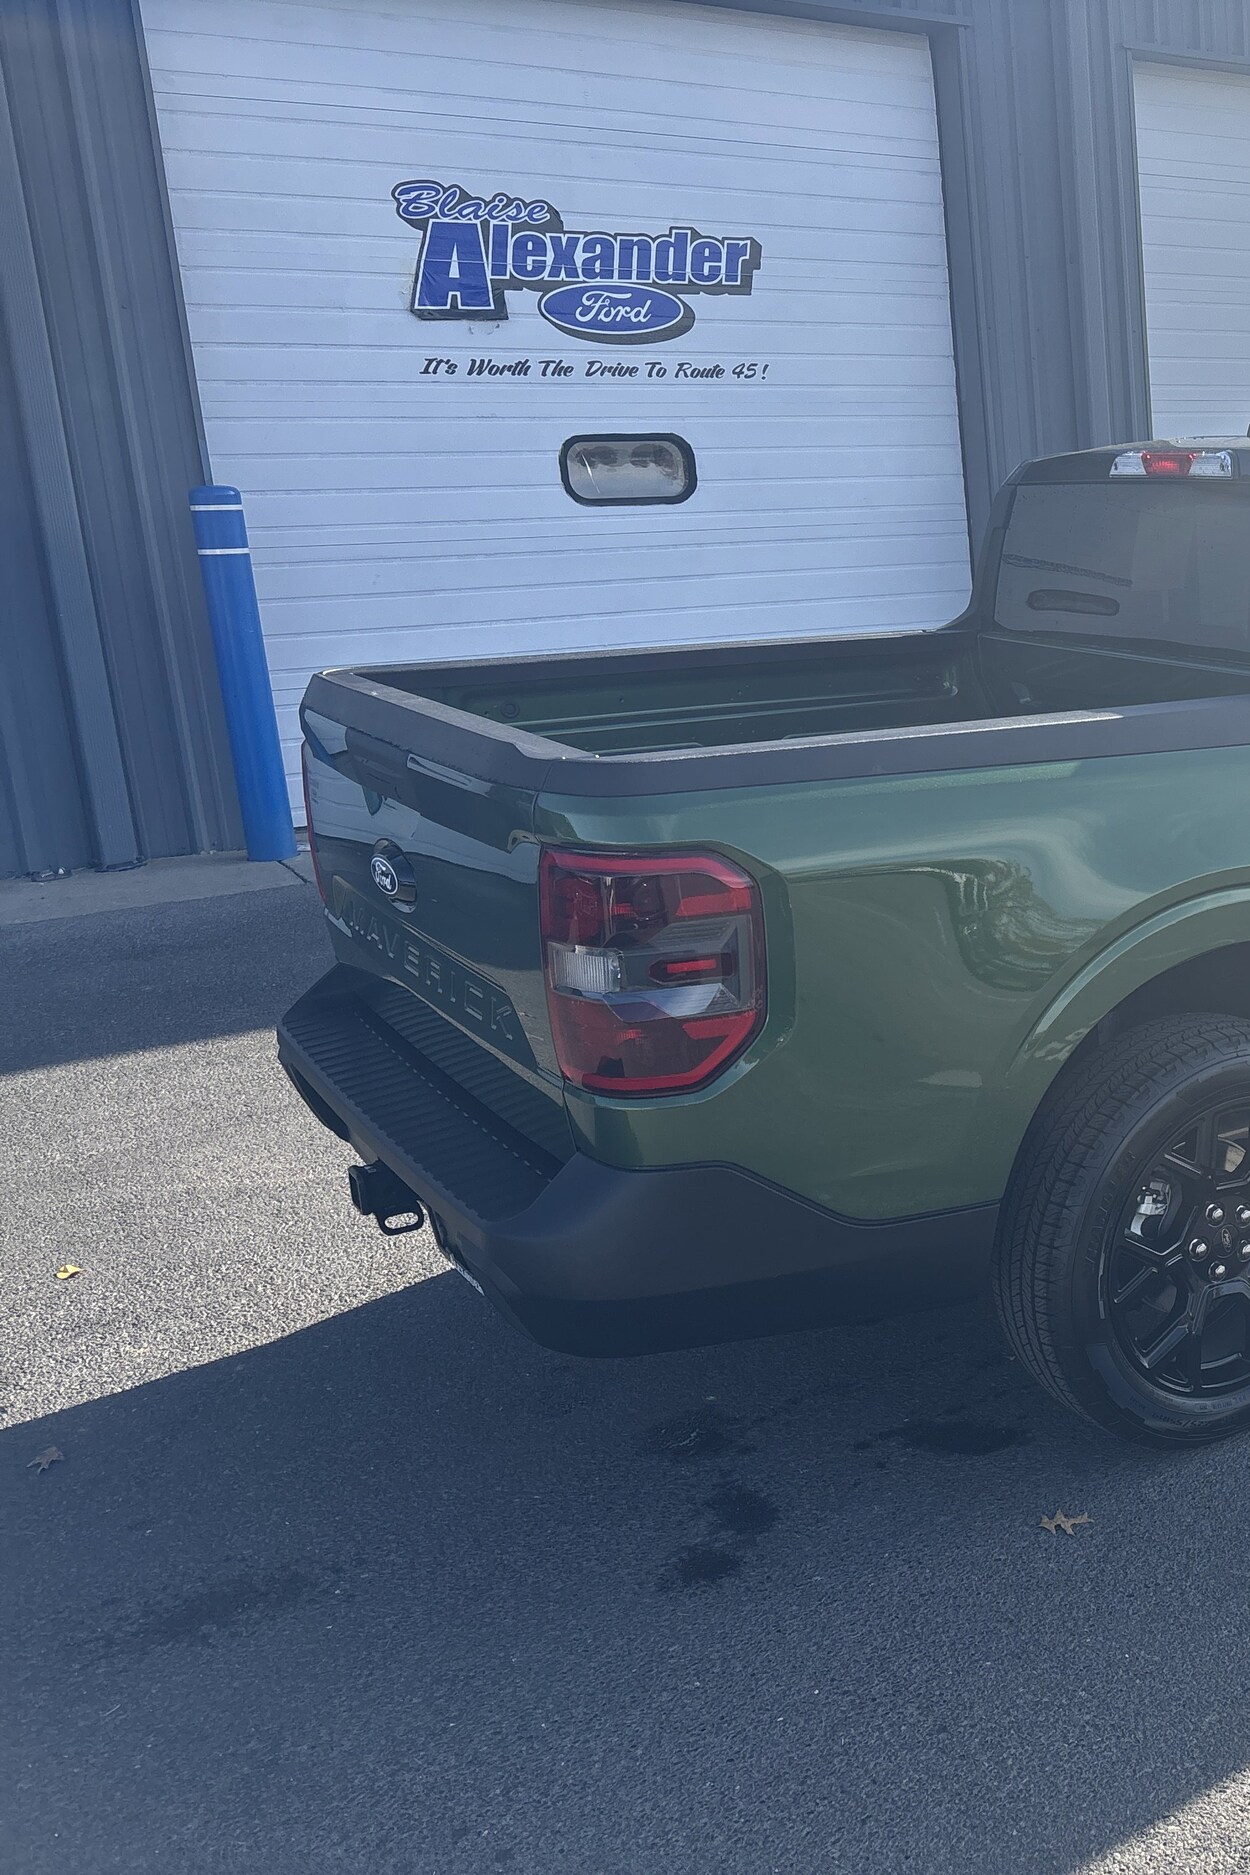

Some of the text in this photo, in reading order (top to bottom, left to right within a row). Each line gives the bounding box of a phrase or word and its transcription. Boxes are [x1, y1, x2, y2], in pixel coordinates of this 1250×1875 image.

[396, 183, 551, 224] Blaise
[414, 219, 751, 311] Alexander
[575, 290, 653, 323] Ford
[419, 357, 457, 376] It's
[466, 358, 532, 378] Worth
[538, 359, 574, 378] The
[584, 360, 640, 380] Drive
[644, 362, 668, 380] To
[674, 363, 726, 381] Route
[374, 861, 392, 890] Ford
[350, 900, 513, 1041] MAVERICK
